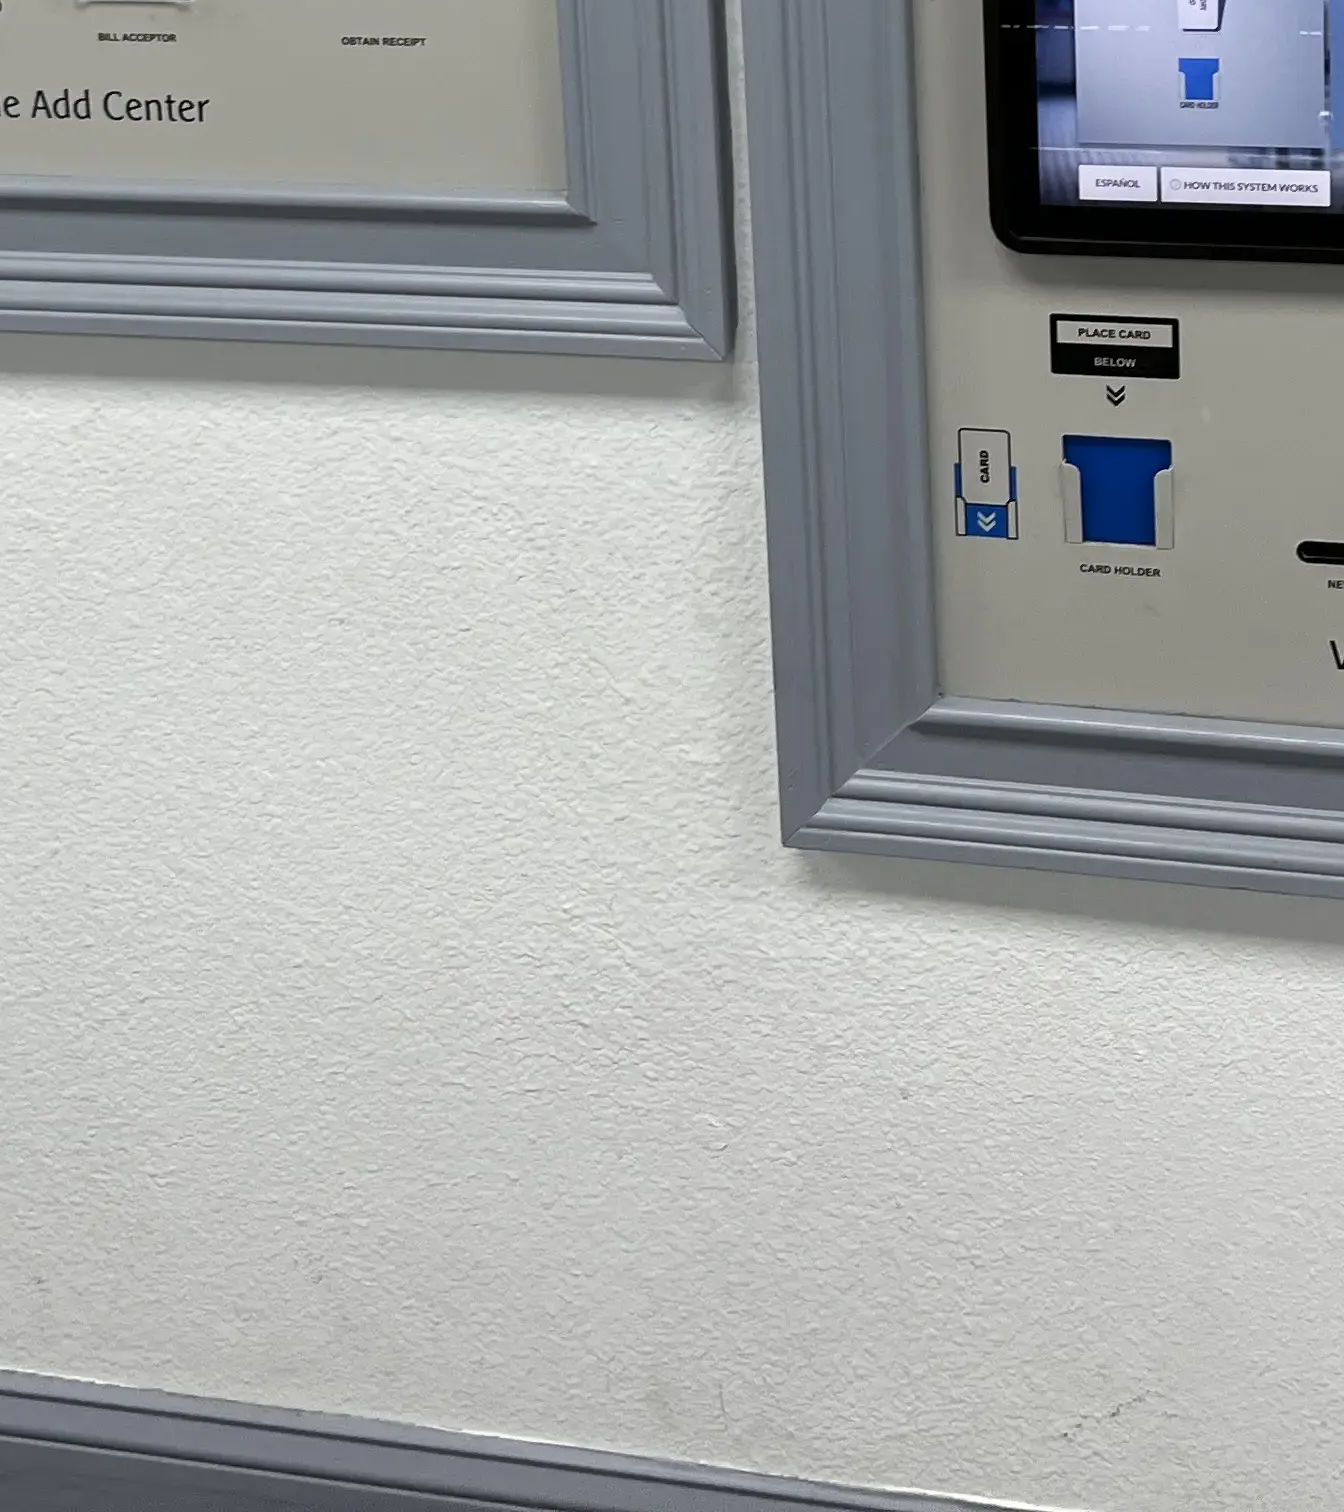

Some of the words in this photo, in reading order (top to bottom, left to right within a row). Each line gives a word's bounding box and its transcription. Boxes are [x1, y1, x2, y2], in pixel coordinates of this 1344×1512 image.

[98, 33, 119, 42] BILL
[122, 33, 177, 43] ACCEPTOR
[341, 37, 380, 45] OBTAIN
[382, 37, 427, 46] RECEIPT
[31, 89, 91, 120] Add
[103, 90, 210, 122] Center
[1184, 181, 1211, 190] HOW
[1213, 182, 1235, 190] THIS
[1237, 183, 1278, 192] SYSTEM
[1279, 184, 1319, 192] WORKS
[1078, 328, 1117, 338] PLACE
[1119, 329, 1151, 340] CARD
[1094, 357, 1136, 368] BELOW
[979, 450, 990, 483] CARD
[1079, 564, 1112, 574] CARD
[1114, 566, 1161, 577] HOLDER
